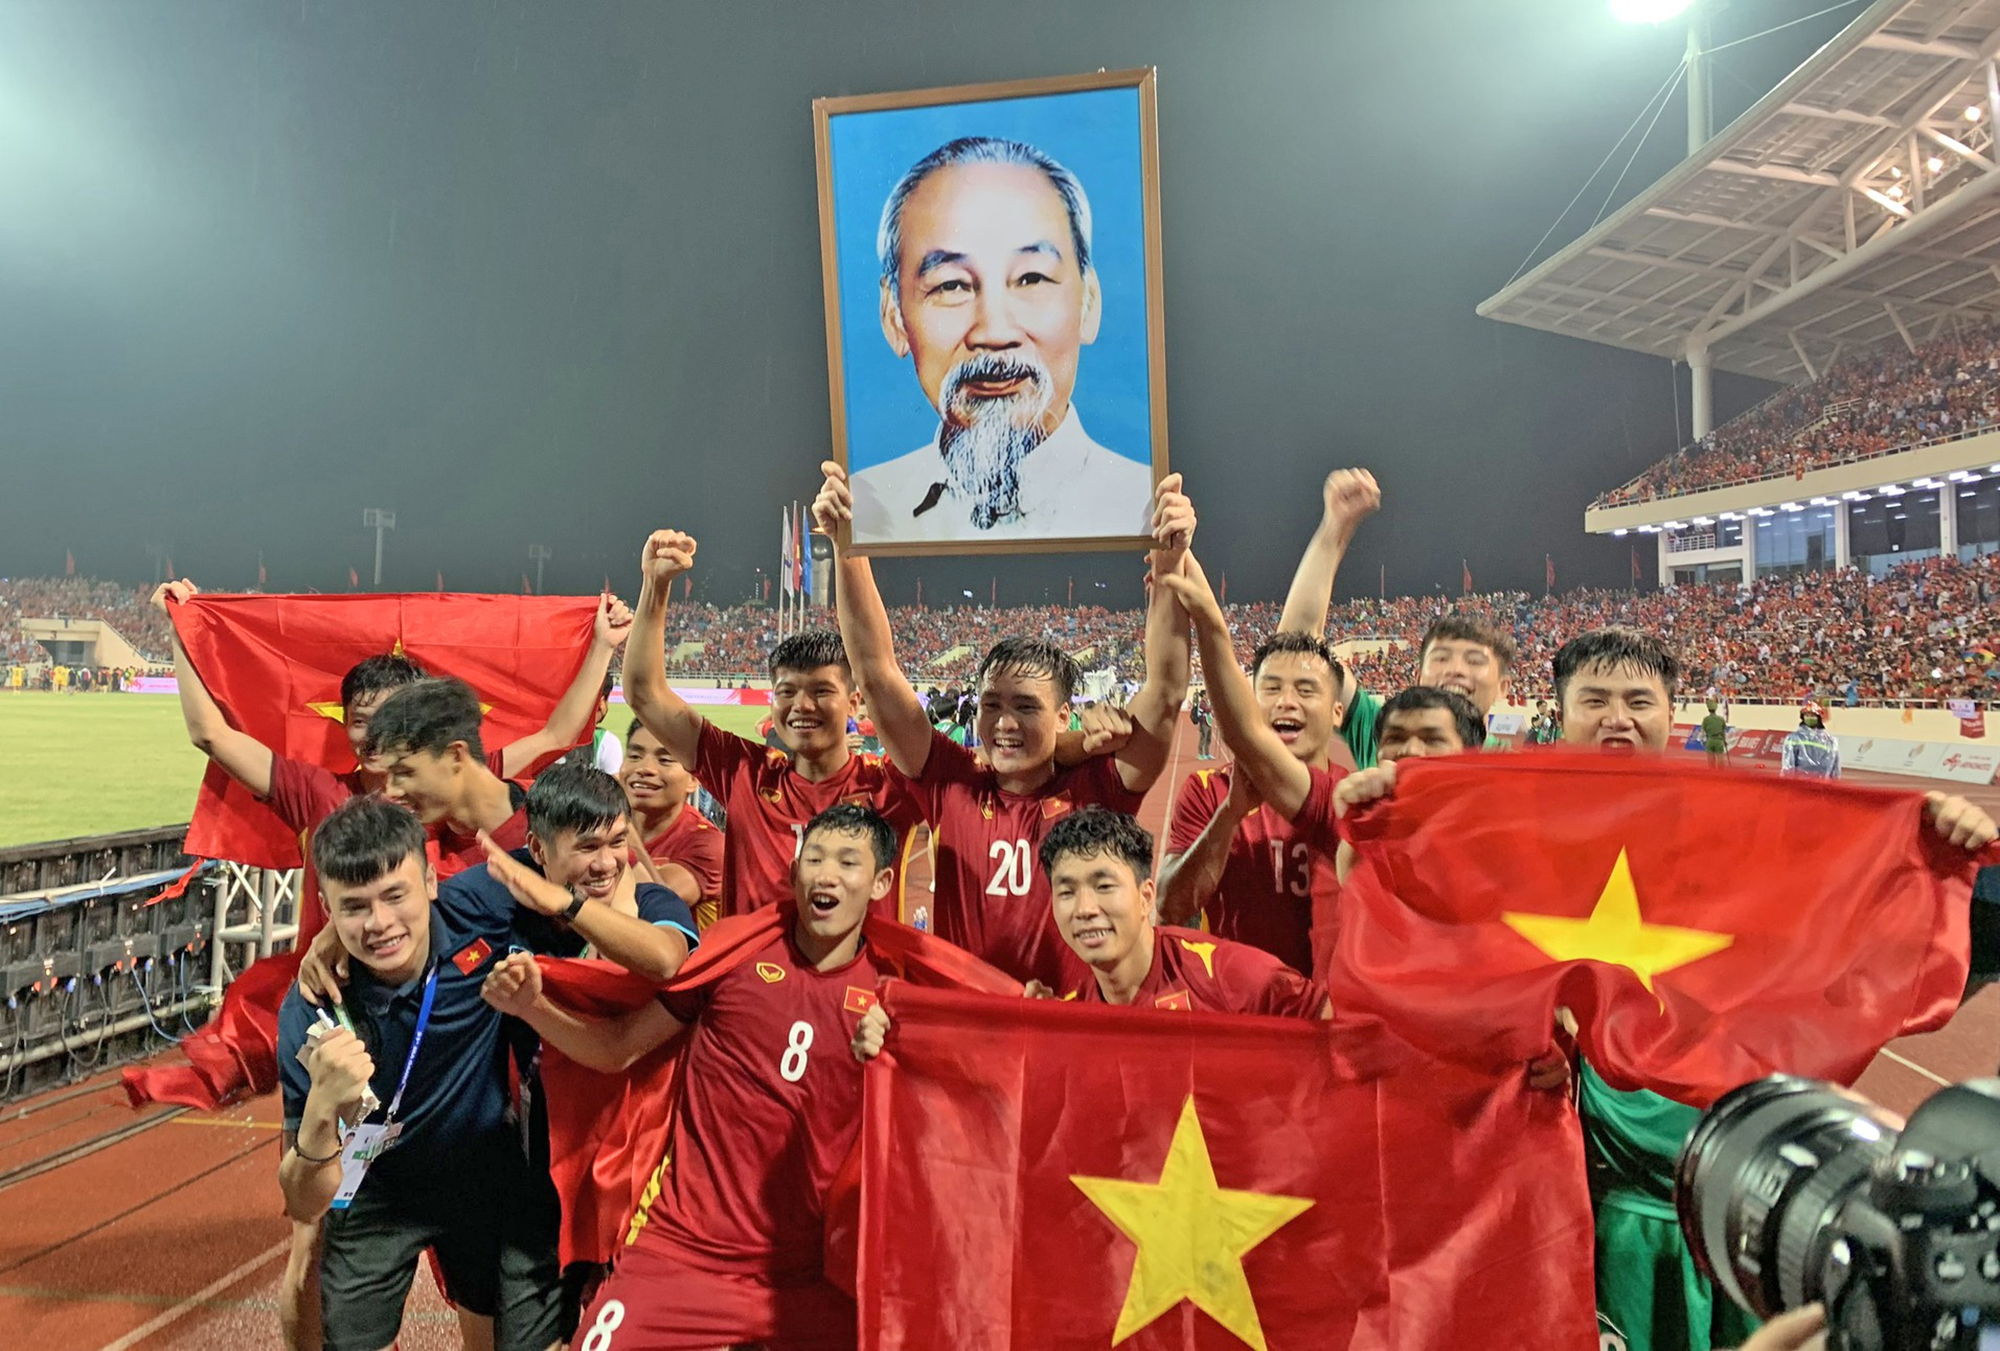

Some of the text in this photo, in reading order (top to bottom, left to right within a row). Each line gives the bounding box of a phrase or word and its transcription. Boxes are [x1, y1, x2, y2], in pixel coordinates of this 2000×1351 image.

[985, 838, 1032, 897] 20
[1270, 839, 1310, 897] 13
[780, 1020, 814, 1082] 8
[581, 1299, 625, 1351] 8
